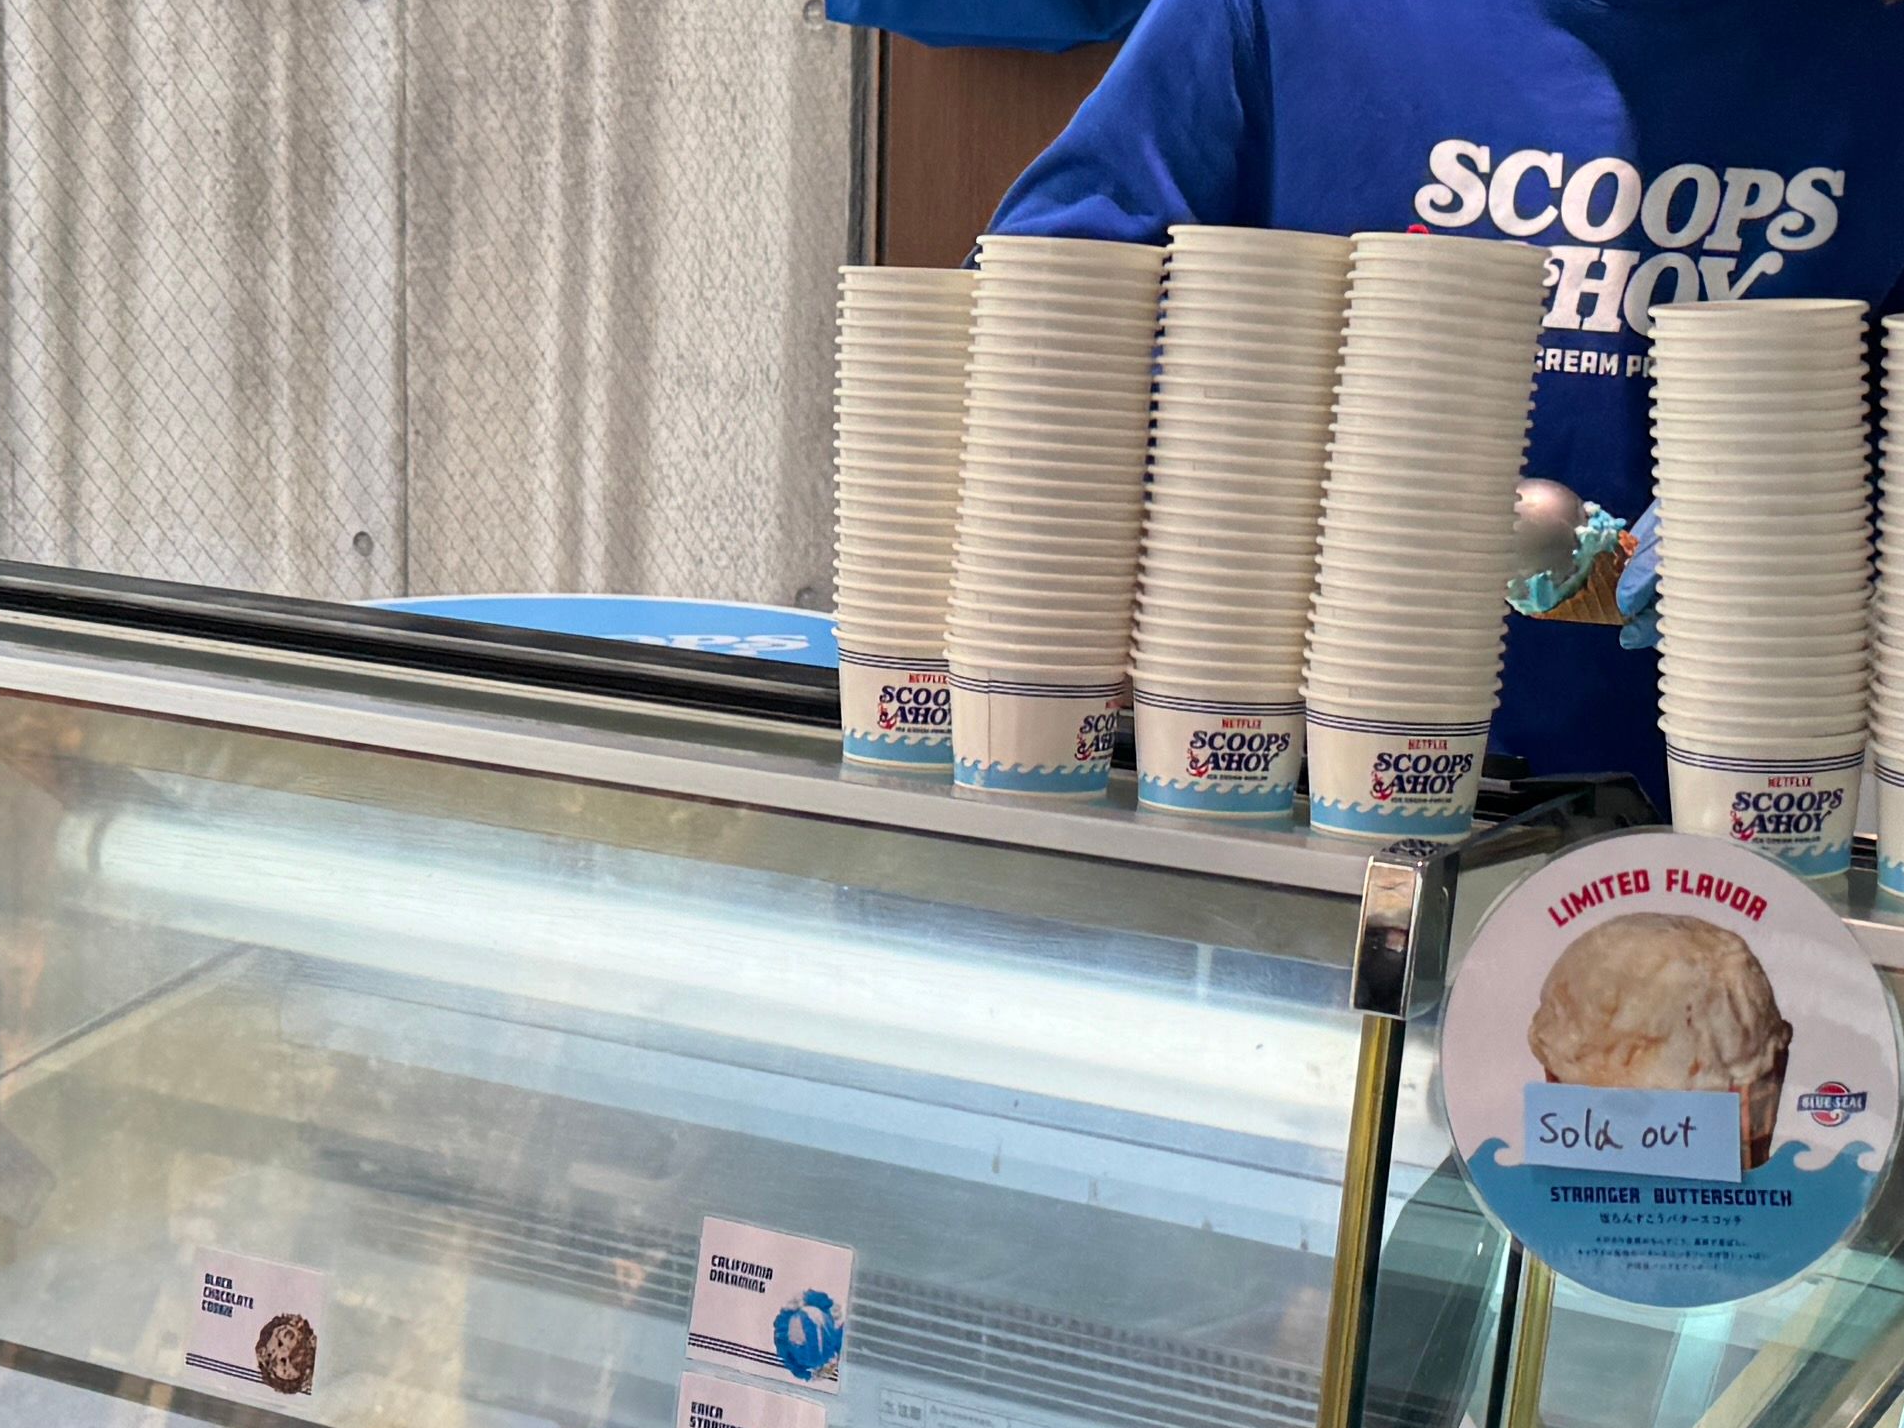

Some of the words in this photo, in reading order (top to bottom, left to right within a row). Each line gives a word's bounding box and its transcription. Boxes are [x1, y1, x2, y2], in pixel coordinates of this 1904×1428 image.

[1414, 138, 1846, 252] SCOOPS
[1541, 244, 1784, 338] HOY
[879, 685, 951, 707] SCOO
[879, 706, 952, 725] AHO
[1222, 719, 1263, 730] NETFLIX
[1190, 730, 1291, 753] SCOOPS
[1408, 739, 1448, 751] NETFLIX
[1188, 751, 1280, 772] AHOY
[1373, 753, 1474, 774] SCOOPS
[1372, 772, 1463, 795] AHOY
[1768, 776, 1814, 789] NETFLIX
[1731, 787, 1845, 815] SCOOPS
[1731, 810, 1833, 834] AHOY
[1547, 868, 1651, 929] LIMITED
[1665, 868, 1769, 923] FLAVOR
[1801, 1095, 1832, 1110] BLUE
[1833, 1095, 1865, 1110] SEAL
[1538, 1108, 1624, 1152] Sold
[1641, 1114, 1699, 1149] out
[1550, 1186, 1641, 1205] STRANGER
[1653, 1187, 1793, 1207] BUTTERSCOTCH
[711, 1254, 774, 1281] CALIFORNIA
[709, 1268, 766, 1294] DREAMING
[690, 1400, 724, 1420] ERICA
